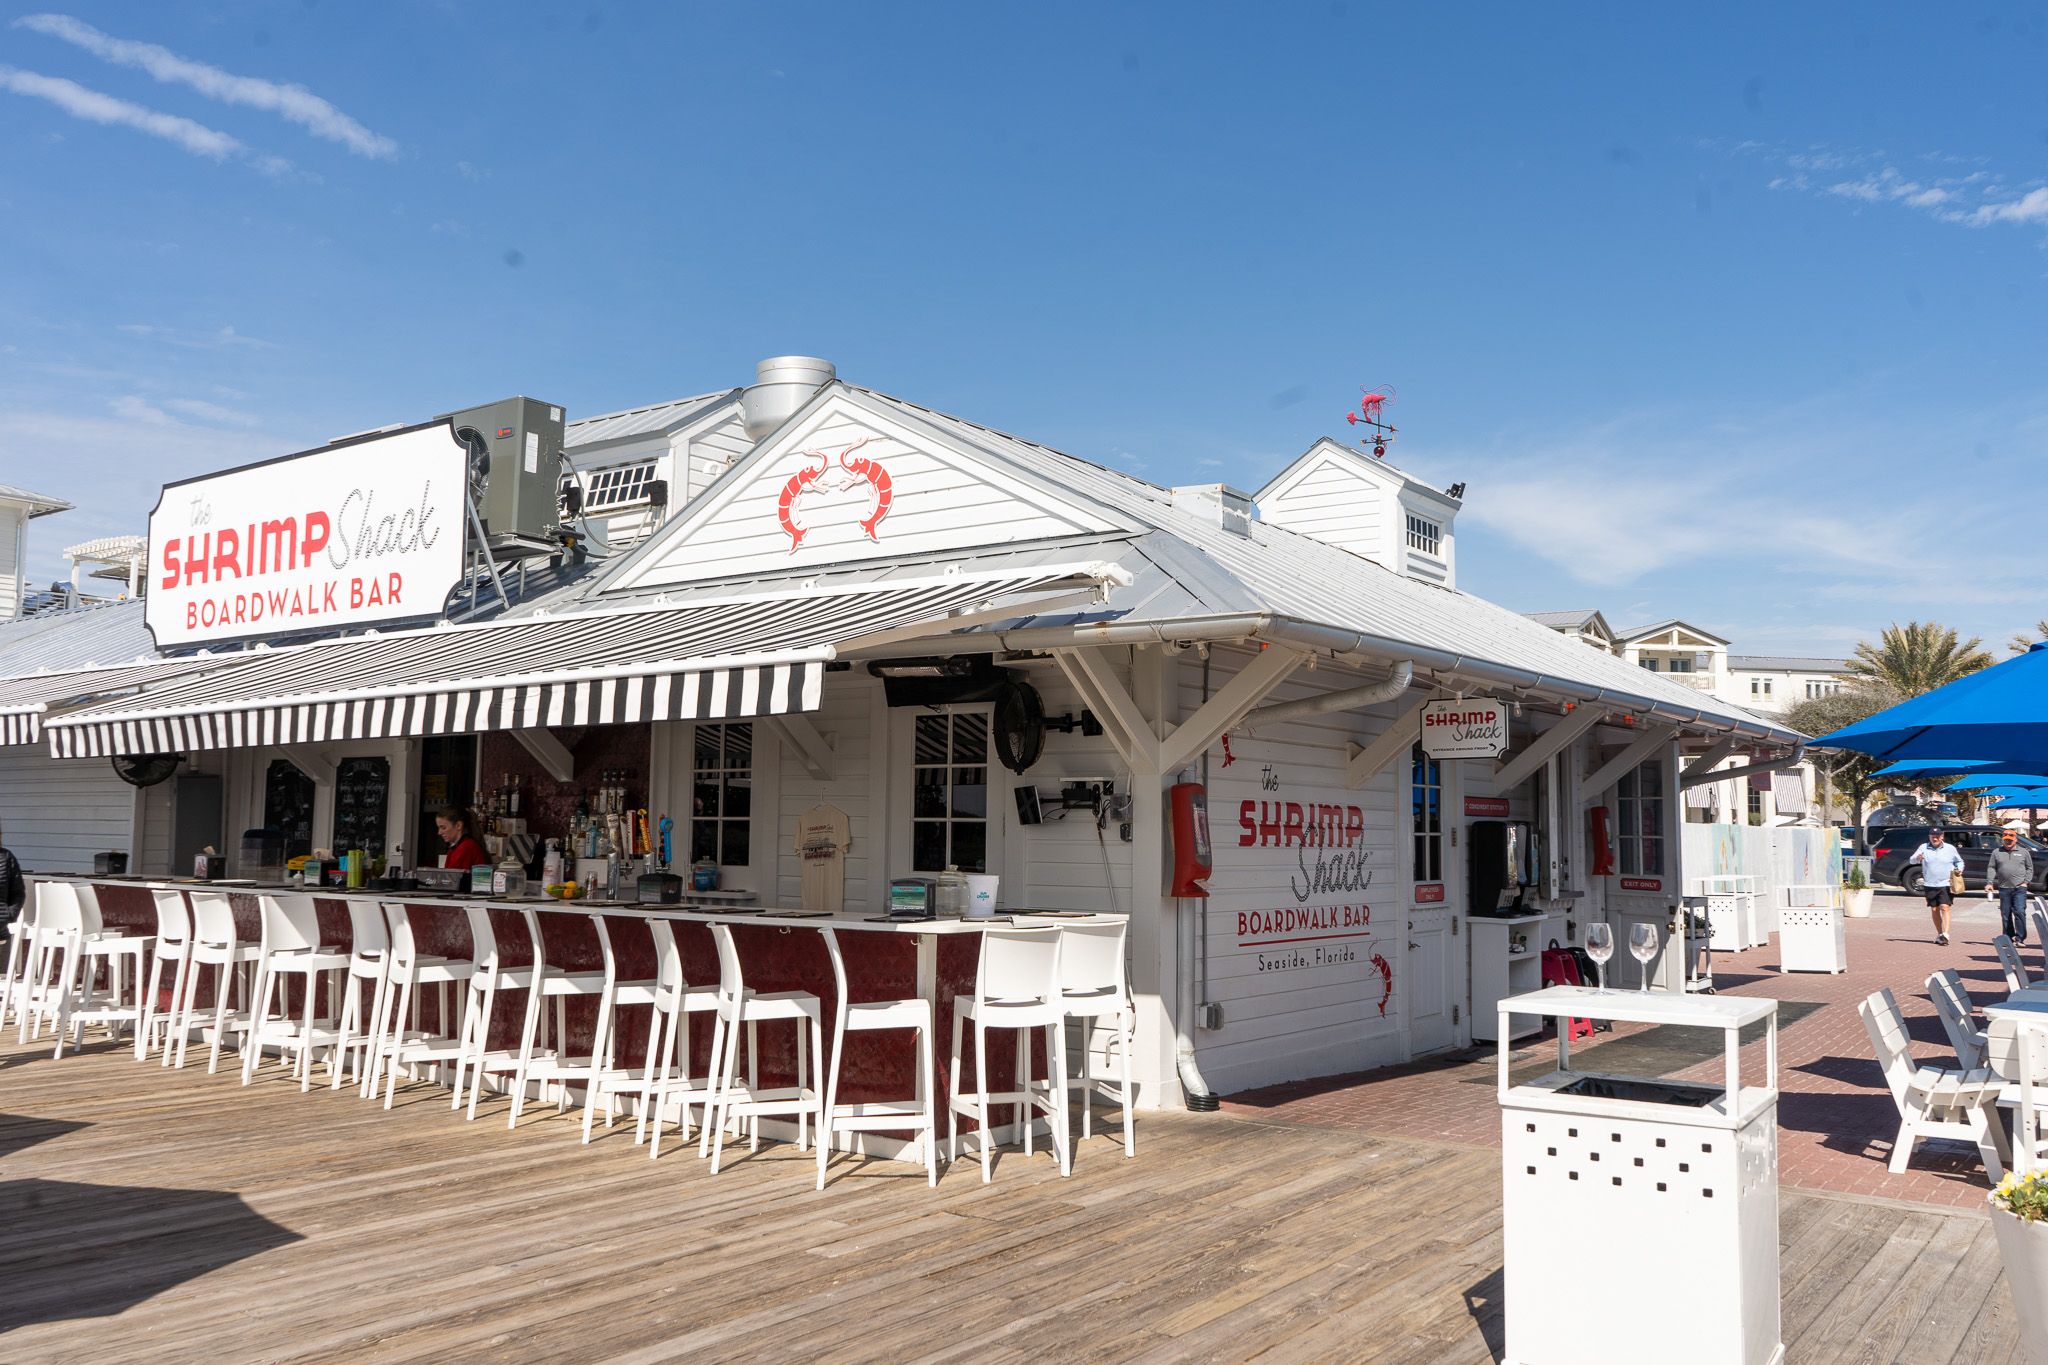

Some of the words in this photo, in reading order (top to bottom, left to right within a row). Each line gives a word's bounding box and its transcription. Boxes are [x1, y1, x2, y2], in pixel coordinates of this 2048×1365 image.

[190, 493, 212, 527] the
[161, 511, 331, 590] SHRIMP
[328, 480, 440, 570] Shack
[186, 580, 338, 630] BOARDWALK
[351, 572, 402, 609] BAR
[1425, 711, 1496, 726] SHRIMP
[1452, 720, 1502, 741] Shack
[1262, 764, 1279, 791] the
[1238, 800, 1364, 848] SHRIMP
[1291, 824, 1372, 902] Shack
[1237, 906, 1338, 936] BOARDWALK
[1344, 904, 1371, 927] BAR
[1258, 950, 1310, 971] Seaside,
[1315, 945, 1355, 965] Florida
